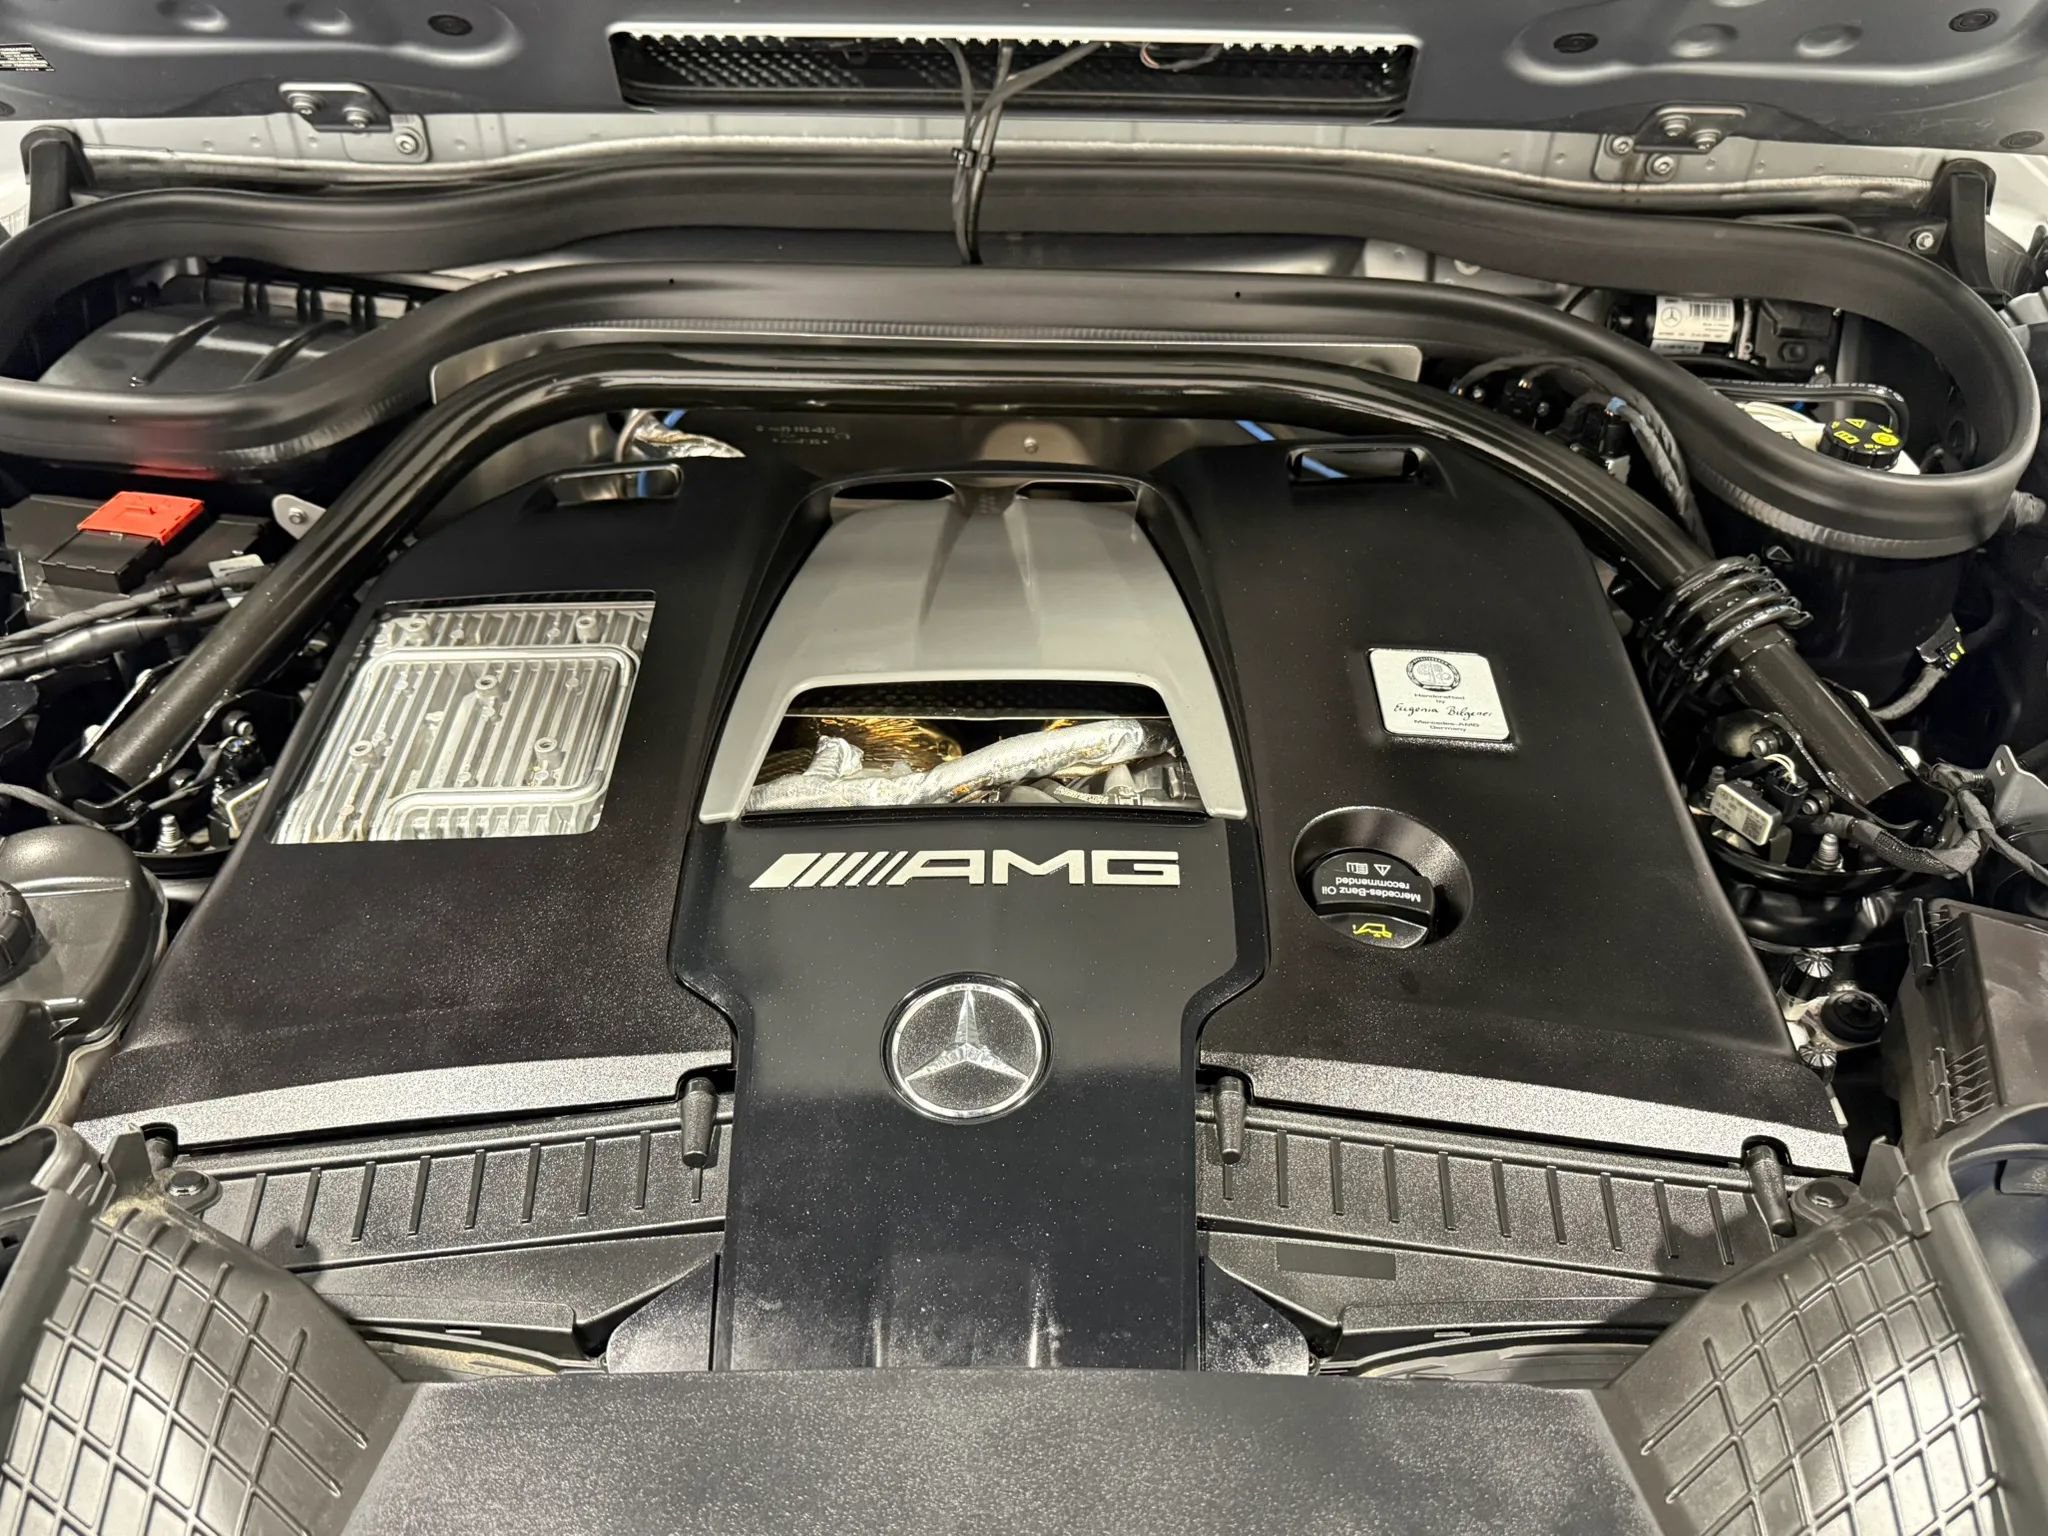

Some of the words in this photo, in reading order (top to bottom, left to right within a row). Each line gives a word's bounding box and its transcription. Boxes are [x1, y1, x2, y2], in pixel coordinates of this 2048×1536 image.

[886, 849, 1180, 887] AMG
[1321, 886, 1337, 895] Oil
[1336, 877, 1410, 890] recommended
[1339, 886, 1421, 903] Mercedes-Benz
